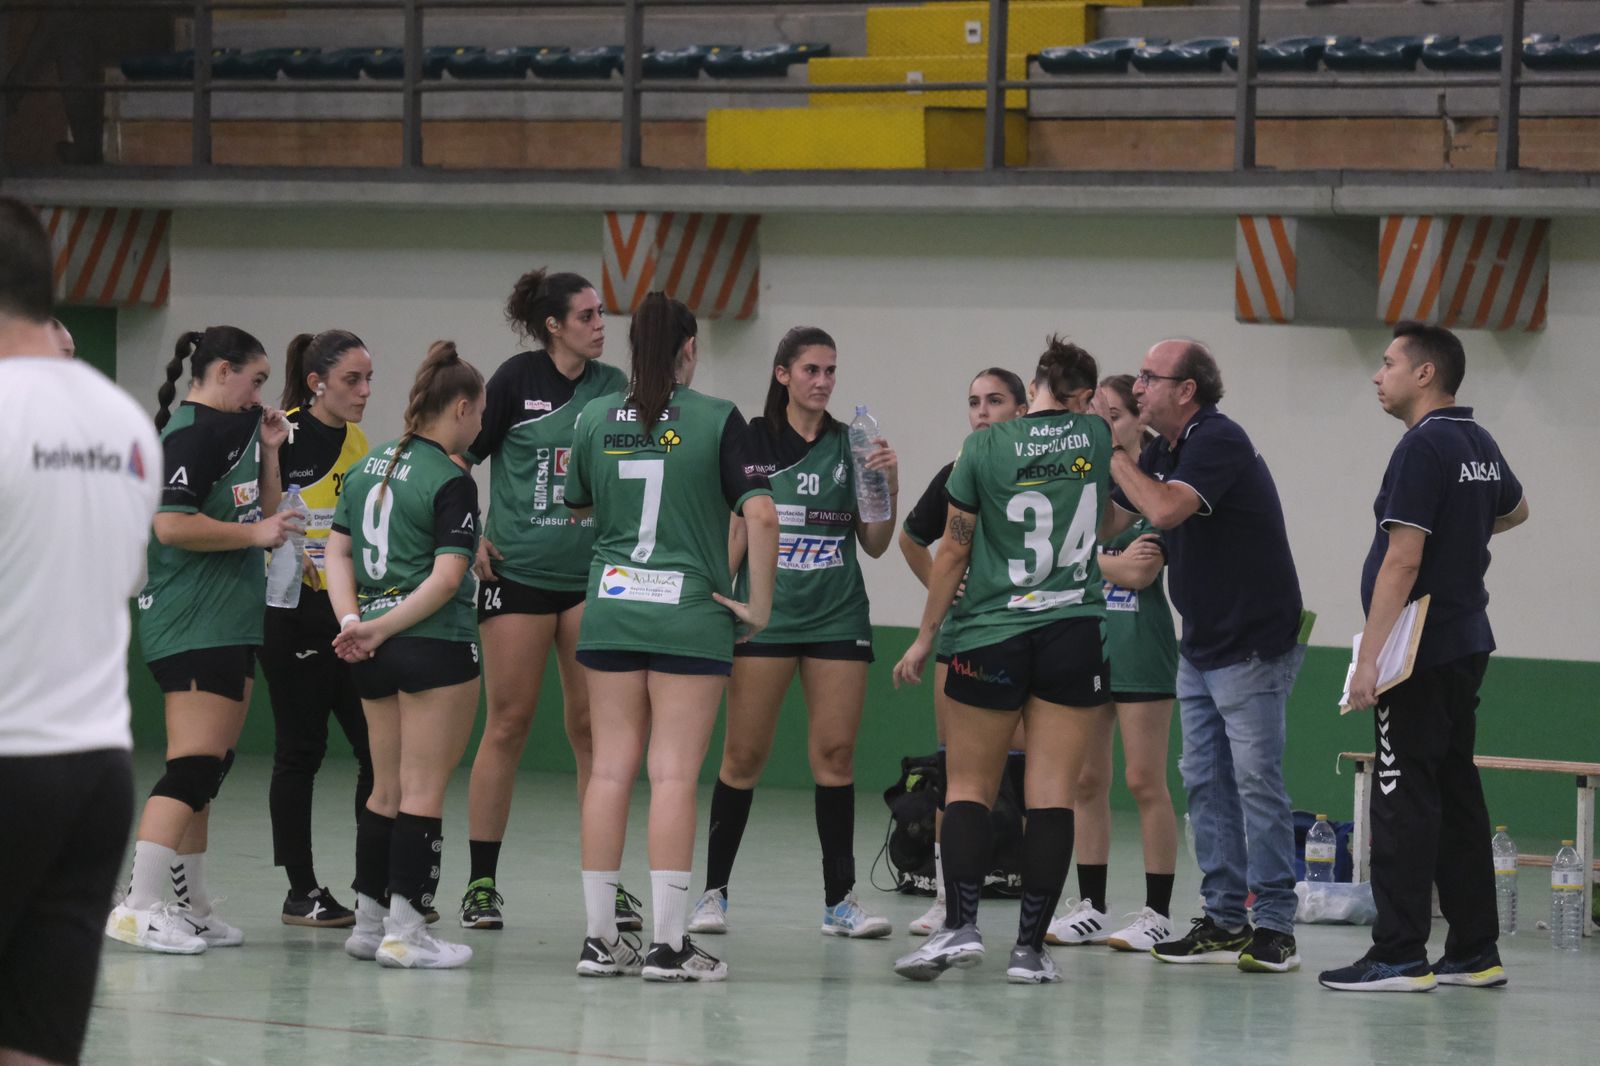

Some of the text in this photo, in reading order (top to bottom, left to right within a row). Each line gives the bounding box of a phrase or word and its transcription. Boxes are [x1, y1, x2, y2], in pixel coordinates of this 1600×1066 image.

[616, 408, 669, 421] RES
[383, 447, 412, 460] Adal
[363, 457, 400, 478] EVELA
[332, 473, 345, 496] 2
[533, 461, 549, 510] EMACSA
[797, 472, 820, 495] 20
[530, 516, 569, 527] cajasur
[618, 459, 665, 563] 7
[362, 481, 394, 580] 9
[1006, 482, 1098, 587] 34
[485, 587, 502, 610] 24
[470, 643, 479, 663] 9
